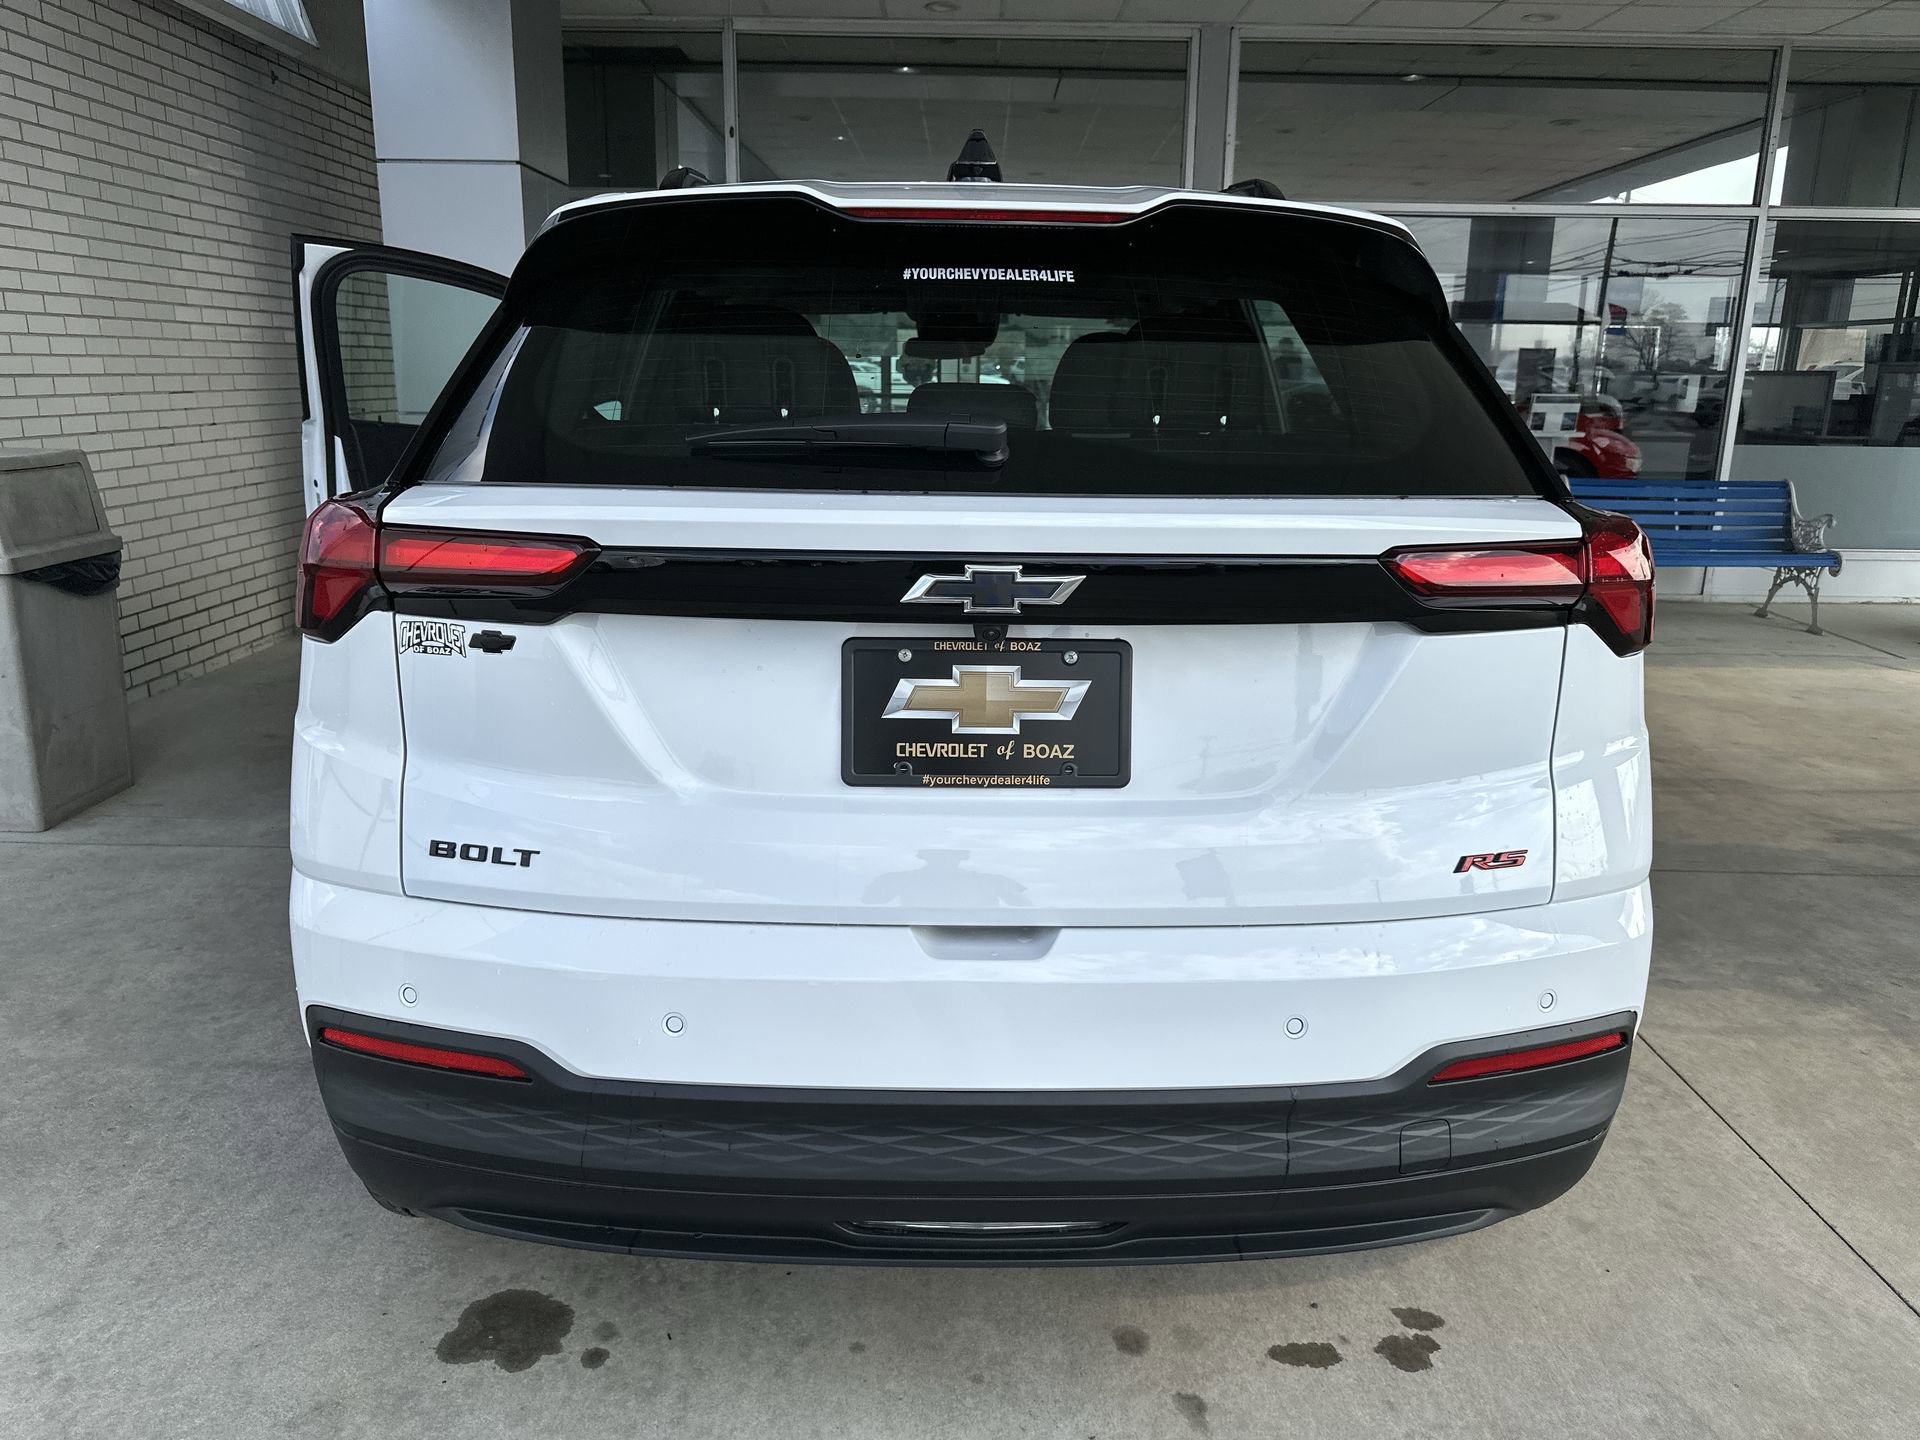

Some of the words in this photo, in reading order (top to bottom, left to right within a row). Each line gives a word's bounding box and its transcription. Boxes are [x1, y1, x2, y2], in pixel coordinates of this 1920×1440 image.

[902, 267, 1075, 283] #YOURCHEVYDEALER4LIFE
[399, 620, 467, 658] CHEVROLET
[1010, 641, 1042, 651] BOAZ
[413, 645, 425, 653] OF
[426, 646, 452, 655] BOAZ
[896, 742, 988, 758] CHEVROLET
[996, 740, 1016, 760] of
[1023, 743, 1075, 759] BOAZ
[922, 774, 1051, 787] #yourchevydealer4life
[428, 839, 541, 868] BOLT
[1452, 849, 1528, 873] RS
